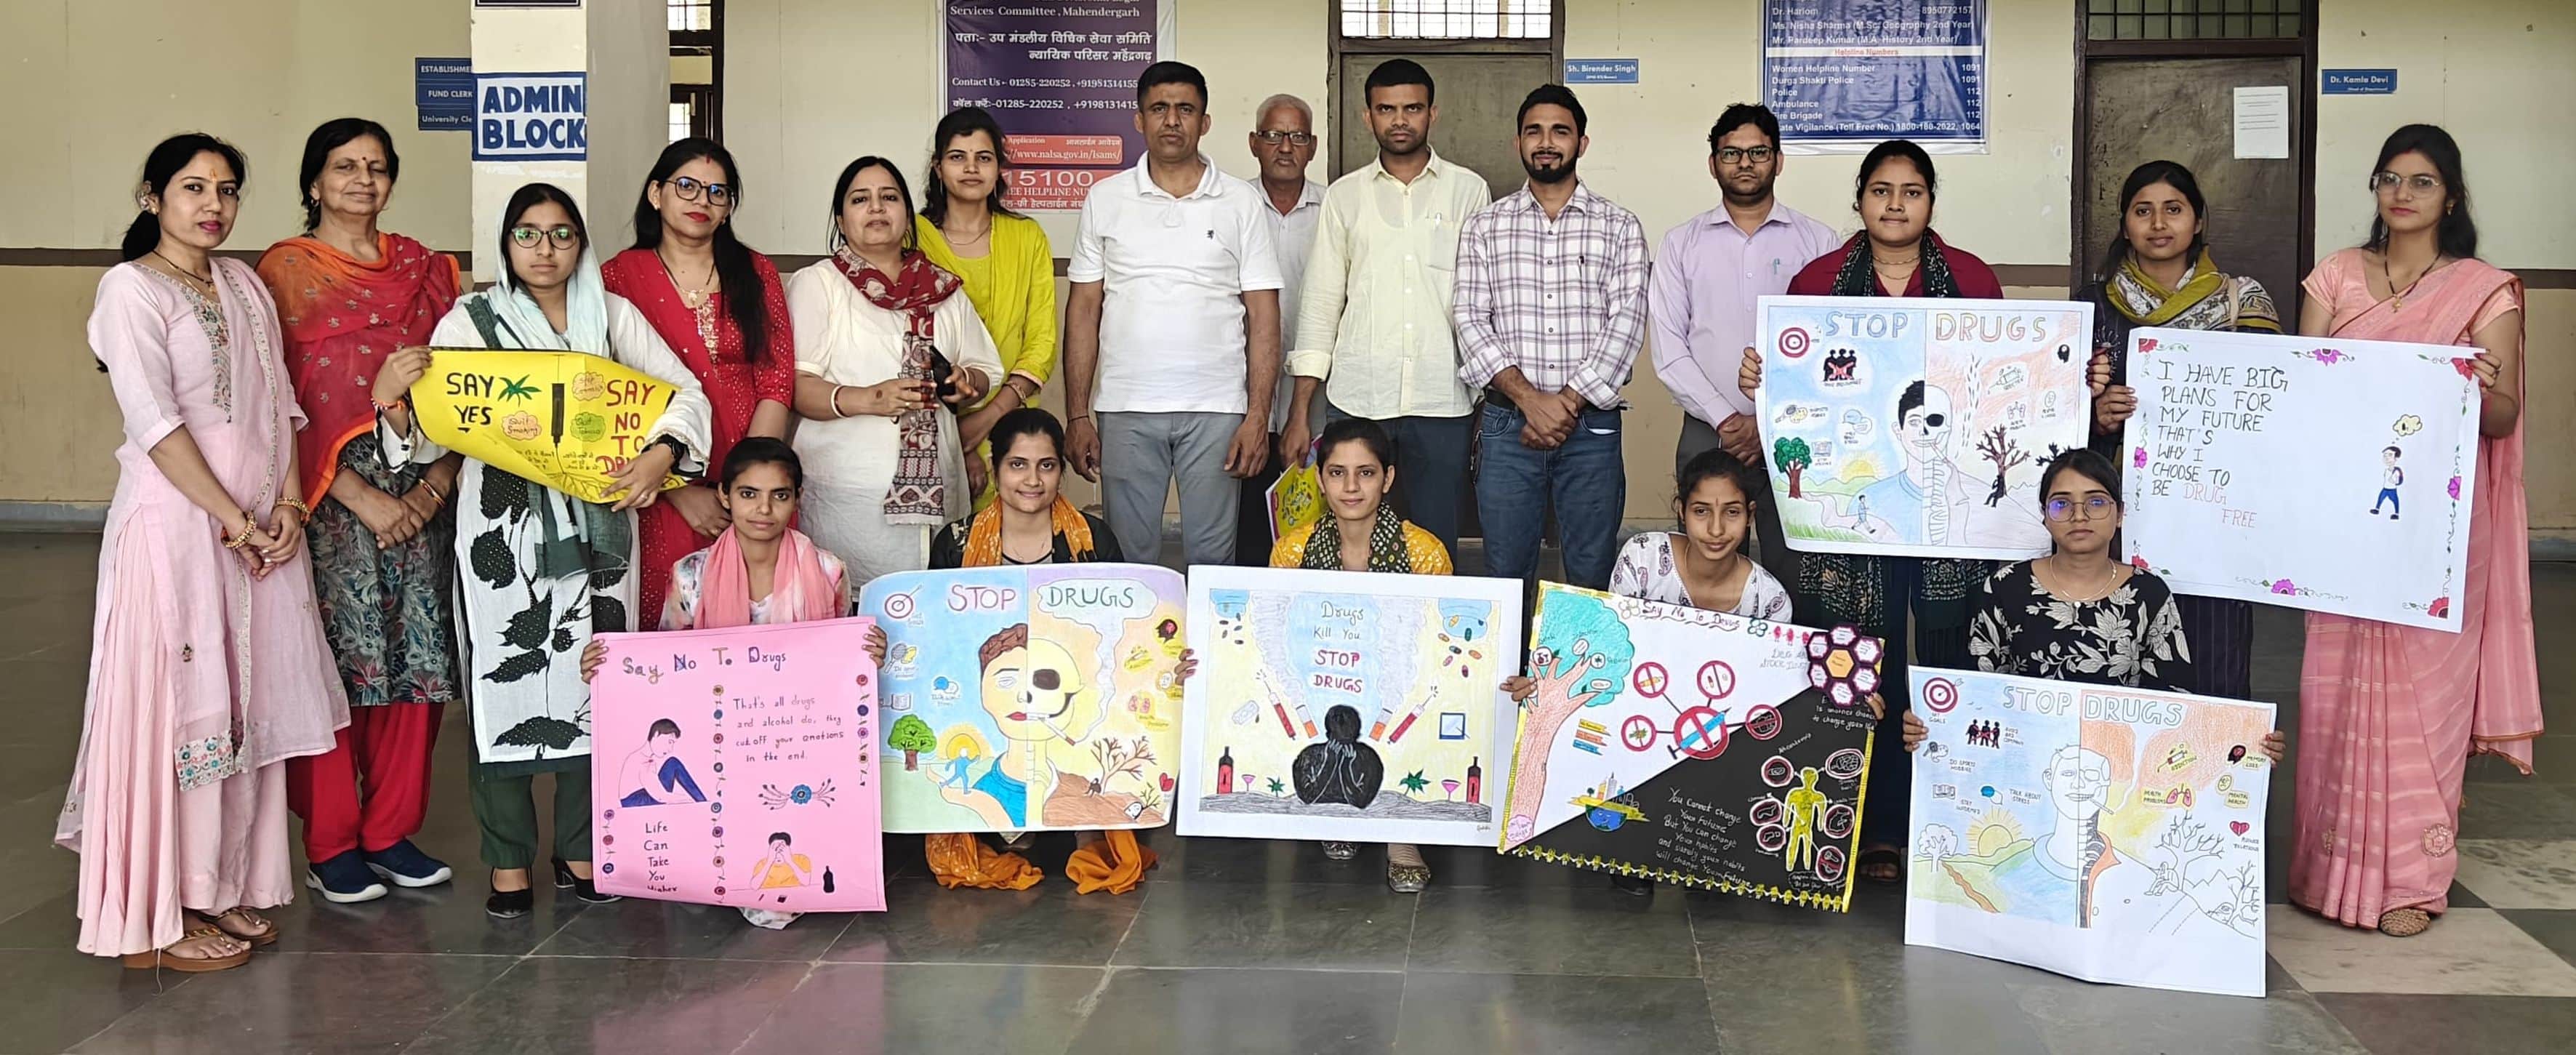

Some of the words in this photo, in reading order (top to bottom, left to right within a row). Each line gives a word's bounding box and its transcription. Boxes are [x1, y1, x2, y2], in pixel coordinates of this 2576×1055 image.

[950, 5, 993, 16] Services
[998, 6, 1055, 16] Committee
[1062, 7, 1140, 18] Mahendergarh
[989, 33, 1005, 42] उप
[1008, 30, 1046, 43] मंडलीय
[1090, 31, 1112, 44] सेवा
[1116, 31, 1152, 44] समिति
[1789, 36, 1823, 45] Pardeep
[1075, 47, 1109, 60] परिसर
[1806, 65, 1839, 73] Helpline
[952, 78, 987, 87] Contact
[482, 85, 582, 113] ADMIN
[422, 116, 459, 124] University
[1790, 112, 1823, 121] Brigade
[482, 119, 586, 149] BLOCK
[1795, 124, 1833, 132] Vigilance
[1001, 171, 1094, 186] 15100
[1024, 188, 1071, 196] HELPLINE
[1825, 310, 1909, 339] STOP
[1935, 313, 2046, 342] DRUGS
[446, 372, 494, 398] SAY
[2158, 361, 2174, 381] I
[2187, 365, 2233, 386] HAVE
[2244, 366, 2289, 392] BIG
[606, 380, 657, 406] SAY
[2161, 385, 2216, 407] PLANS
[2234, 390, 2274, 412] FOR
[454, 405, 493, 427] YES
[615, 412, 641, 433] NO
[2160, 406, 2188, 423] MY
[2202, 410, 2263, 433] FUTURE
[507, 425, 538, 436] Smoking
[2158, 425, 2213, 446] THAT'S
[611, 436, 646, 455] TO
[2158, 444, 2186, 460] WHY
[2194, 448, 2204, 462] I
[2152, 462, 2199, 483] CHOOSE
[2209, 468, 2231, 486] TO
[2152, 479, 2172, 496] BE
[2183, 482, 2226, 505] DRUG
[2222, 508, 2257, 529] FREE
[947, 584, 1016, 611] STOP
[1047, 586, 1134, 608] DRUGS
[1320, 601, 1364, 620] Drugs
[1313, 626, 1331, 640] Kill
[1343, 628, 1360, 641] You
[622, 657, 664, 684] Say
[674, 654, 697, 672] No
[748, 646, 786, 672] Drugs
[1315, 650, 1360, 668] STOP
[1313, 674, 1363, 694] DRUGS
[733, 697, 765, 710] That's
[774, 696, 784, 707] all
[791, 695, 815, 710] drugs
[2003, 686, 2071, 715] STOP
[2085, 694, 2183, 726] DRUGS
[737, 718, 753, 728] and
[763, 716, 793, 726] alcohol
[827, 715, 841, 726] they
[775, 737, 793, 749] your
[764, 752, 778, 761] the
[1668, 787, 1683, 804] You
[1715, 809, 1742, 826] change
[646, 821, 668, 833] Life
[1664, 814, 1679, 829] But
[1712, 833, 1737, 850] change
[643, 840, 668, 851] Can
[648, 855, 669, 867] Take
[649, 870, 665, 881] You
